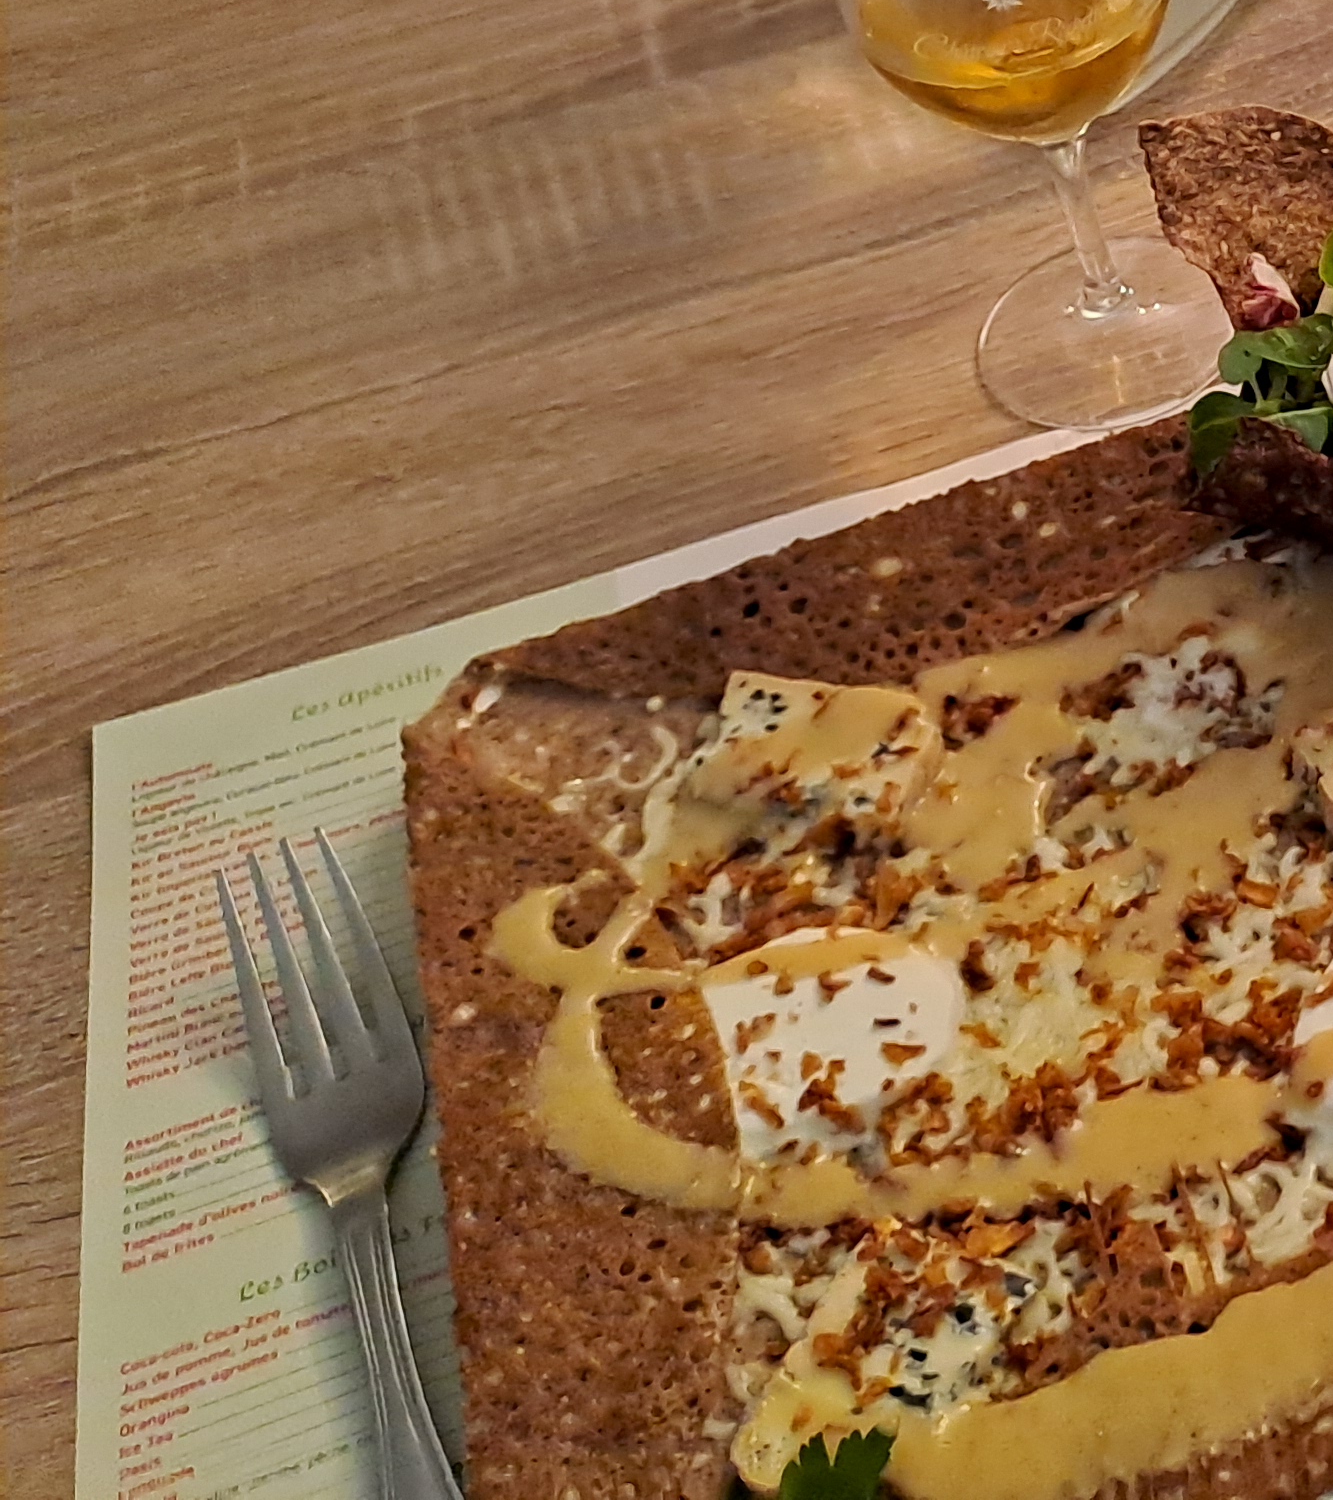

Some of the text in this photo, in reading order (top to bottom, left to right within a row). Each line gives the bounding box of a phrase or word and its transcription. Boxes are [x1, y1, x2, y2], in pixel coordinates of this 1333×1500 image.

[124, 1113, 216, 1152] Assortiment
[123, 1155, 184, 1183] Assiette
[211, 1131, 244, 1152] chef
[122, 1221, 194, 1253] Tapenade
[121, 1255, 147, 1274] Bol
[239, 1275, 284, 1303] Les
[122, 1379, 148, 1397] Jus
[151, 1370, 170, 1385] de
[242, 1333, 268, 1352] Jus
[271, 1325, 291, 1339] de
[118, 1404, 191, 1438] Orangina
